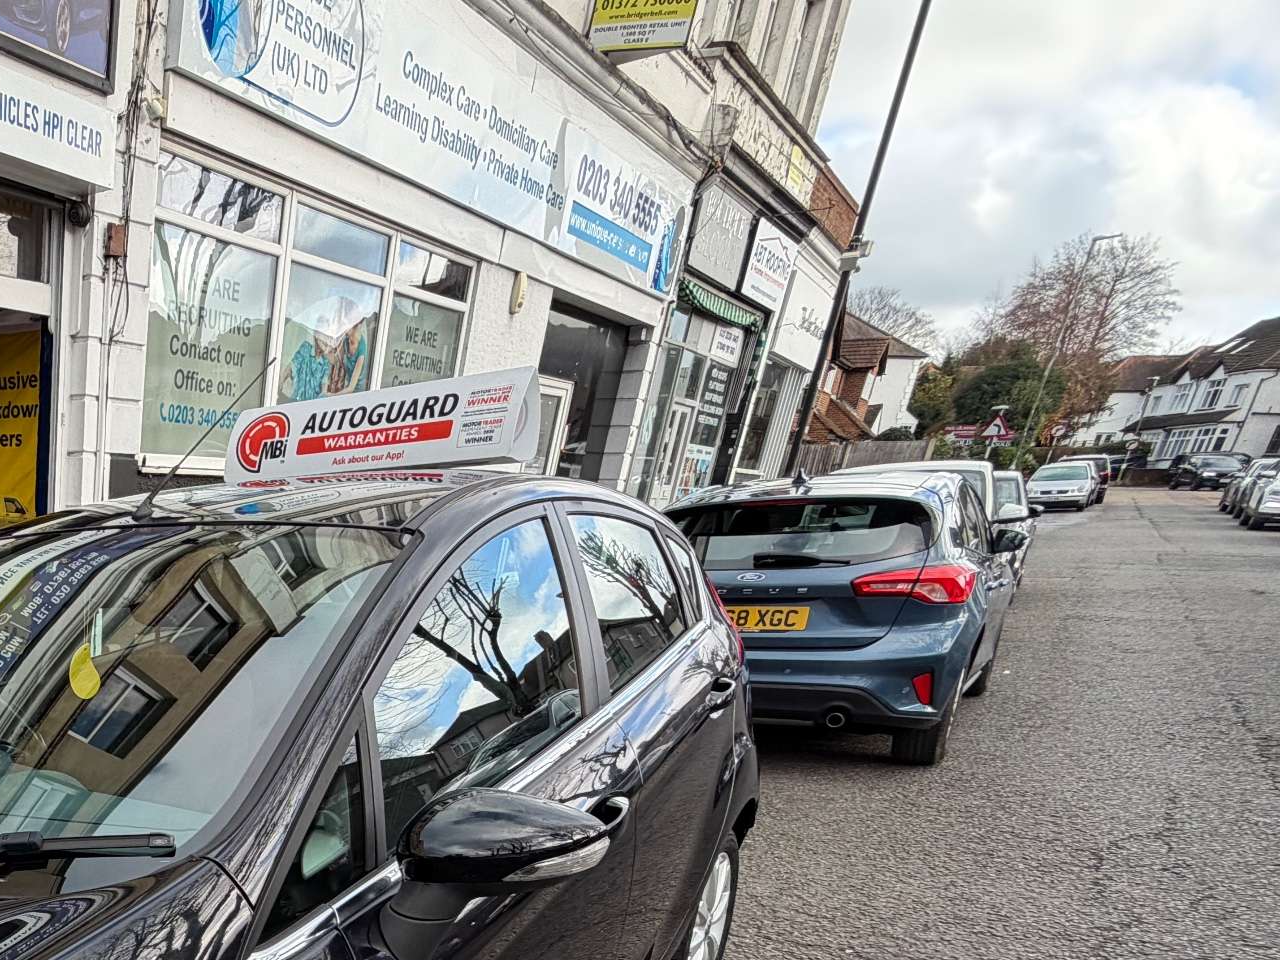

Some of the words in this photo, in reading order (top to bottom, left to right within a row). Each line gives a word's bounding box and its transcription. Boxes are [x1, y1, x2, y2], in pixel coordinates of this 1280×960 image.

[276, 0, 356, 70] PERSONNEL
[594, 25, 619, 33] DOUBLE
[619, 23, 647, 31] FRONTED
[272, 41, 300, 87] (UK)
[304, 60, 328, 95] LTD
[402, 50, 455, 107] Complex
[456, 84, 481, 121] Care
[487, 102, 538, 156] Domiciliary
[538, 133, 559, 170] Care
[42, 108, 63, 141] HPI
[66, 116, 102, 158] CLEAR
[375, 82, 428, 143] Learning
[431, 116, 480, 170] Disability
[487, 151, 519, 189] Private
[519, 166, 545, 202] Home
[545, 182, 564, 213] Care
[577, 154, 609, 207] 0203
[610, 178, 634, 220] 340
[632, 192, 661, 236] 5555
[212, 276, 240, 303] ARE
[168, 300, 251, 337] RECRUITING
[406, 325, 420, 343] WE
[420, 329, 438, 348] ARE
[169, 335, 222, 364] Contact
[224, 350, 246, 368] our
[392, 350, 442, 374] RECRUITING
[174, 370, 213, 393] Office
[217, 380, 237, 397] on:
[391, 375, 420, 387] Cont
[300, 392, 460, 436] AUTOGUARD
[468, 395, 509, 406] WINNER
[167, 404, 195, 425] 0203
[197, 407, 218, 427] 340
[218, 408, 239, 430] 555
[323, 427, 419, 449] WARRANTIES
[465, 436, 493, 444] WINNER
[331, 456, 347, 466] Ask
[348, 455, 370, 465] about
[371, 454, 384, 463] our
[385, 450, 404, 463] App!
[755, 610, 799, 627] XGC
